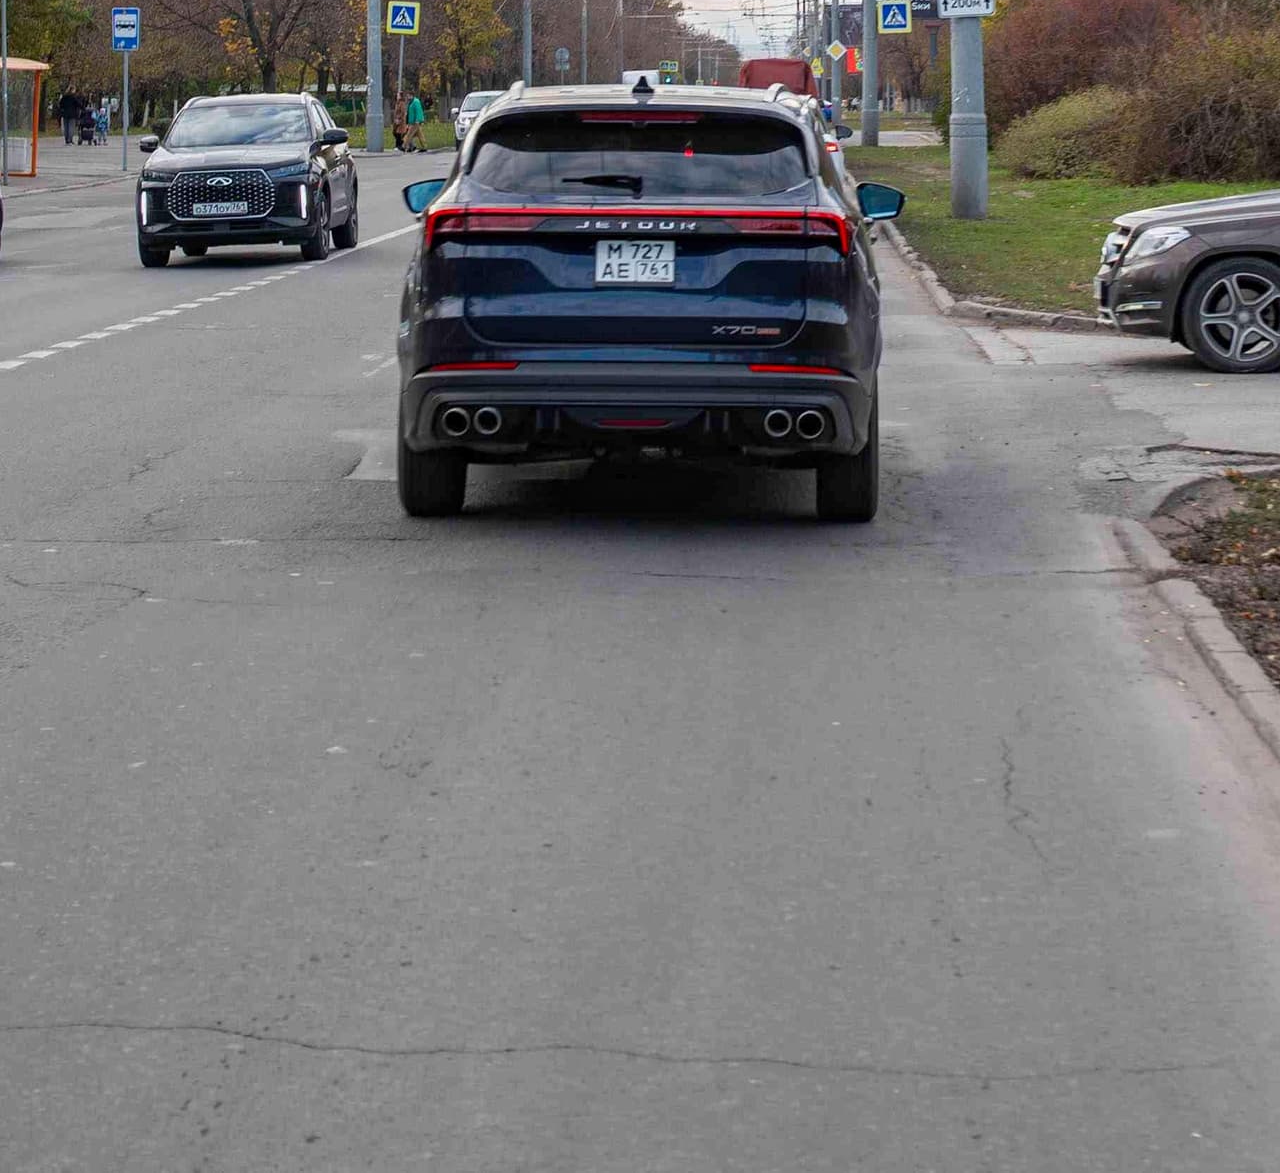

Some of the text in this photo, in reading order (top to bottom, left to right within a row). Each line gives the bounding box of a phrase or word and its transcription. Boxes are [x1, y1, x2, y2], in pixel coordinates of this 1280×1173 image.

[575, 221, 697, 230] JETOUR
[631, 243, 664, 259] 727
[602, 263, 670, 278] АЕ 761
[711, 325, 757, 335] X70
